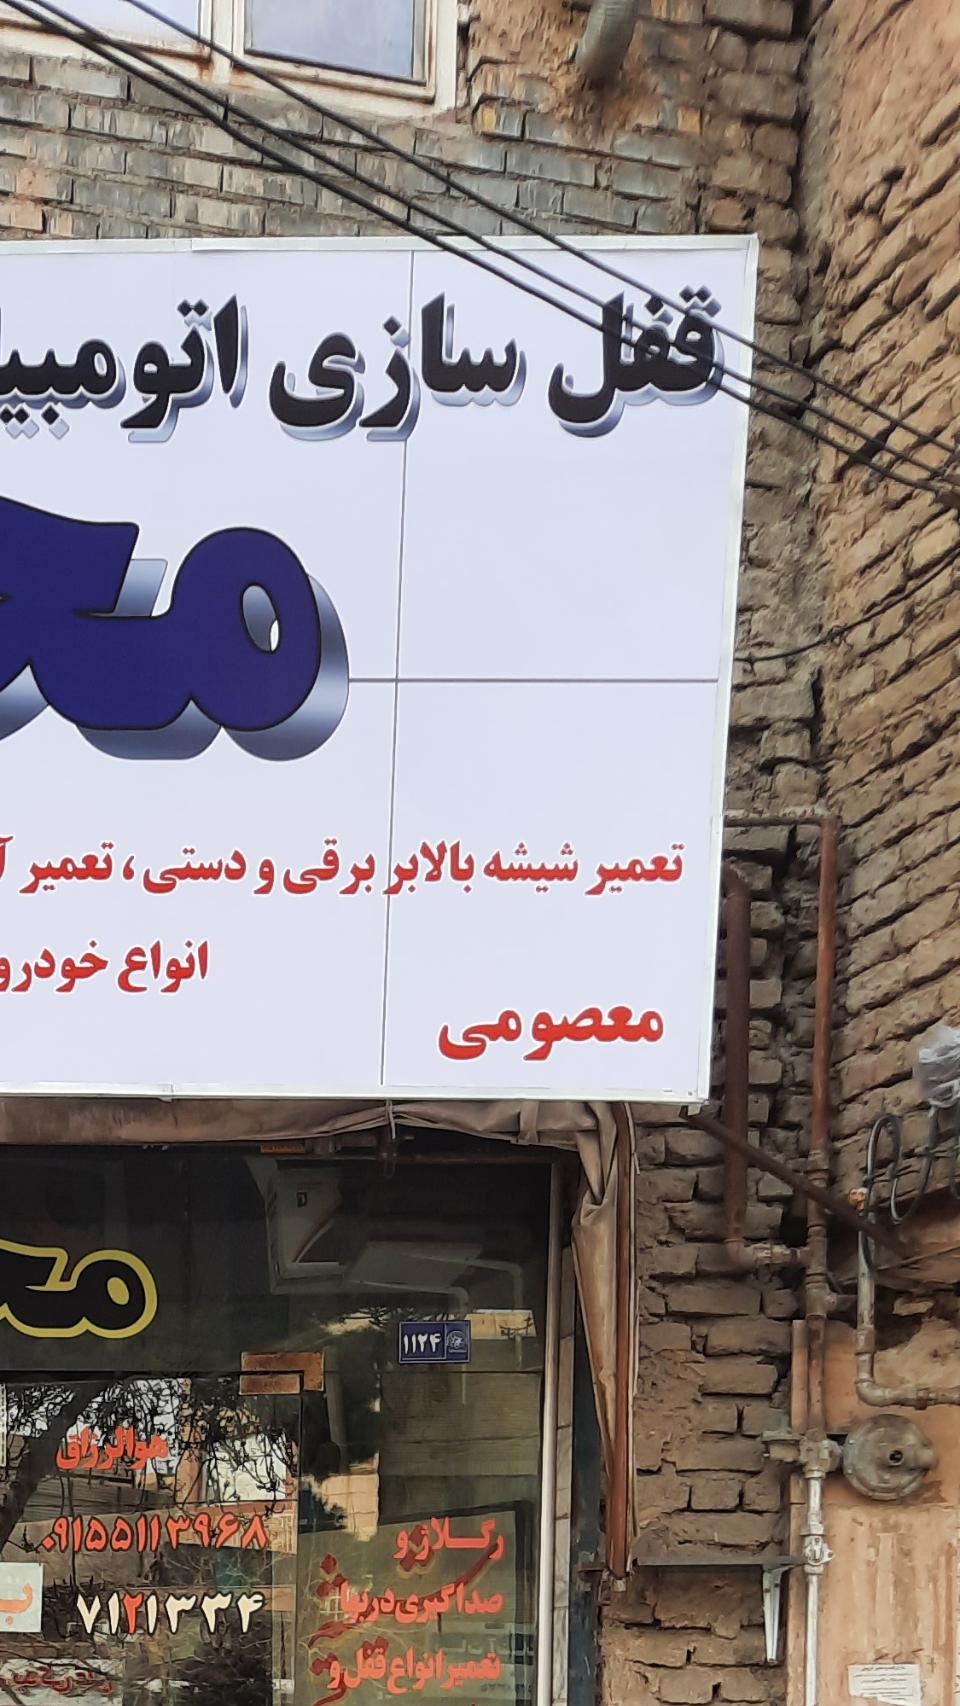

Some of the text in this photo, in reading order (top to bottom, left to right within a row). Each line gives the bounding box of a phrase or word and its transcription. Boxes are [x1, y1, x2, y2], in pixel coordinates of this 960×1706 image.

[269, 292, 528, 440] سازی
[548, 287, 724, 438] قفل
[20, 842, 114, 895] تعمیر
[255, 858, 276, 896] و
[282, 838, 377, 897] برقی
[384, 841, 476, 897] بالابر
[482, 843, 580, 893] شیشه
[586, 844, 685, 897] تعمیر
[116, 939, 209, 994] انواع
[437, 1004, 665, 1062] معصومی
[41, 1512, 268, 1552] ۰۹۱۵۵۱۱۳۹۶۸
[76, 1592, 265, 1635] ۷۱۲۱۳۳۴
